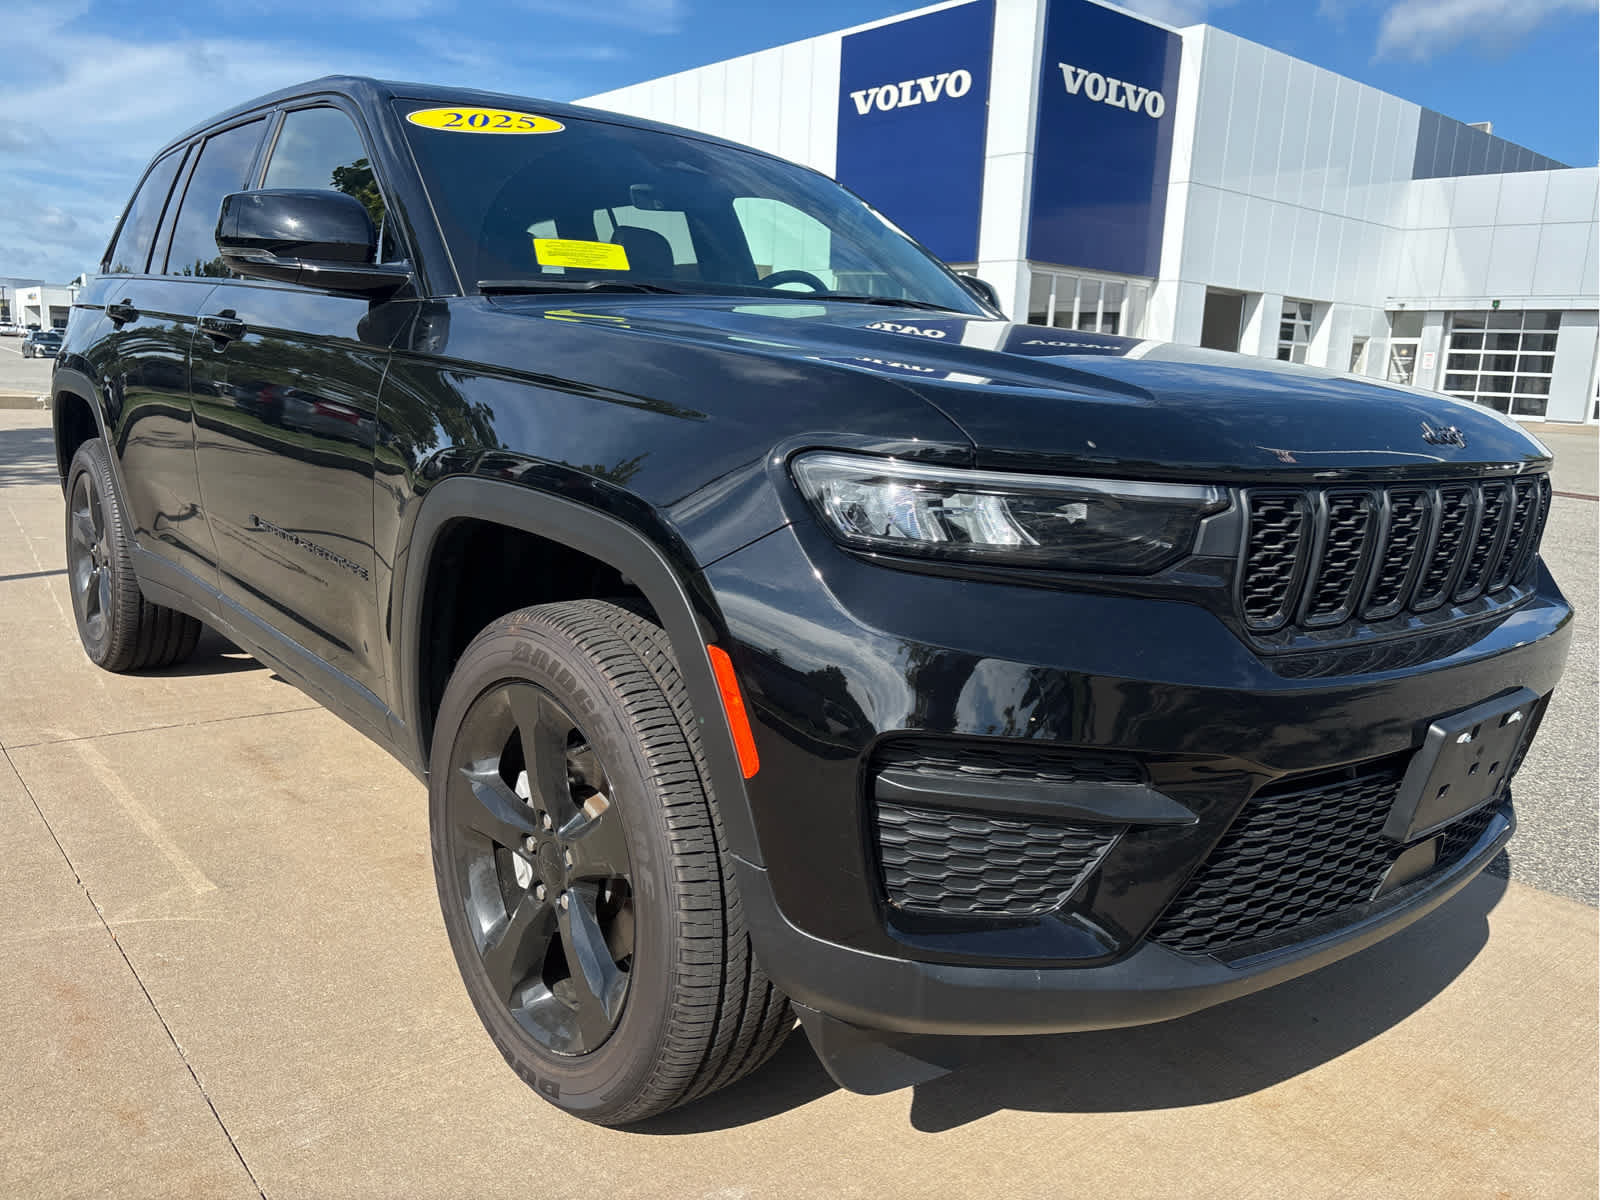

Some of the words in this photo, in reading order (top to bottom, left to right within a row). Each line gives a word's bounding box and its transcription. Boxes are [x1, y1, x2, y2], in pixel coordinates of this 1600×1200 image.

[850, 69, 972, 115] VOLVO
[1058, 62, 1165, 118] VOLVO
[442, 112, 536, 129] 2025
